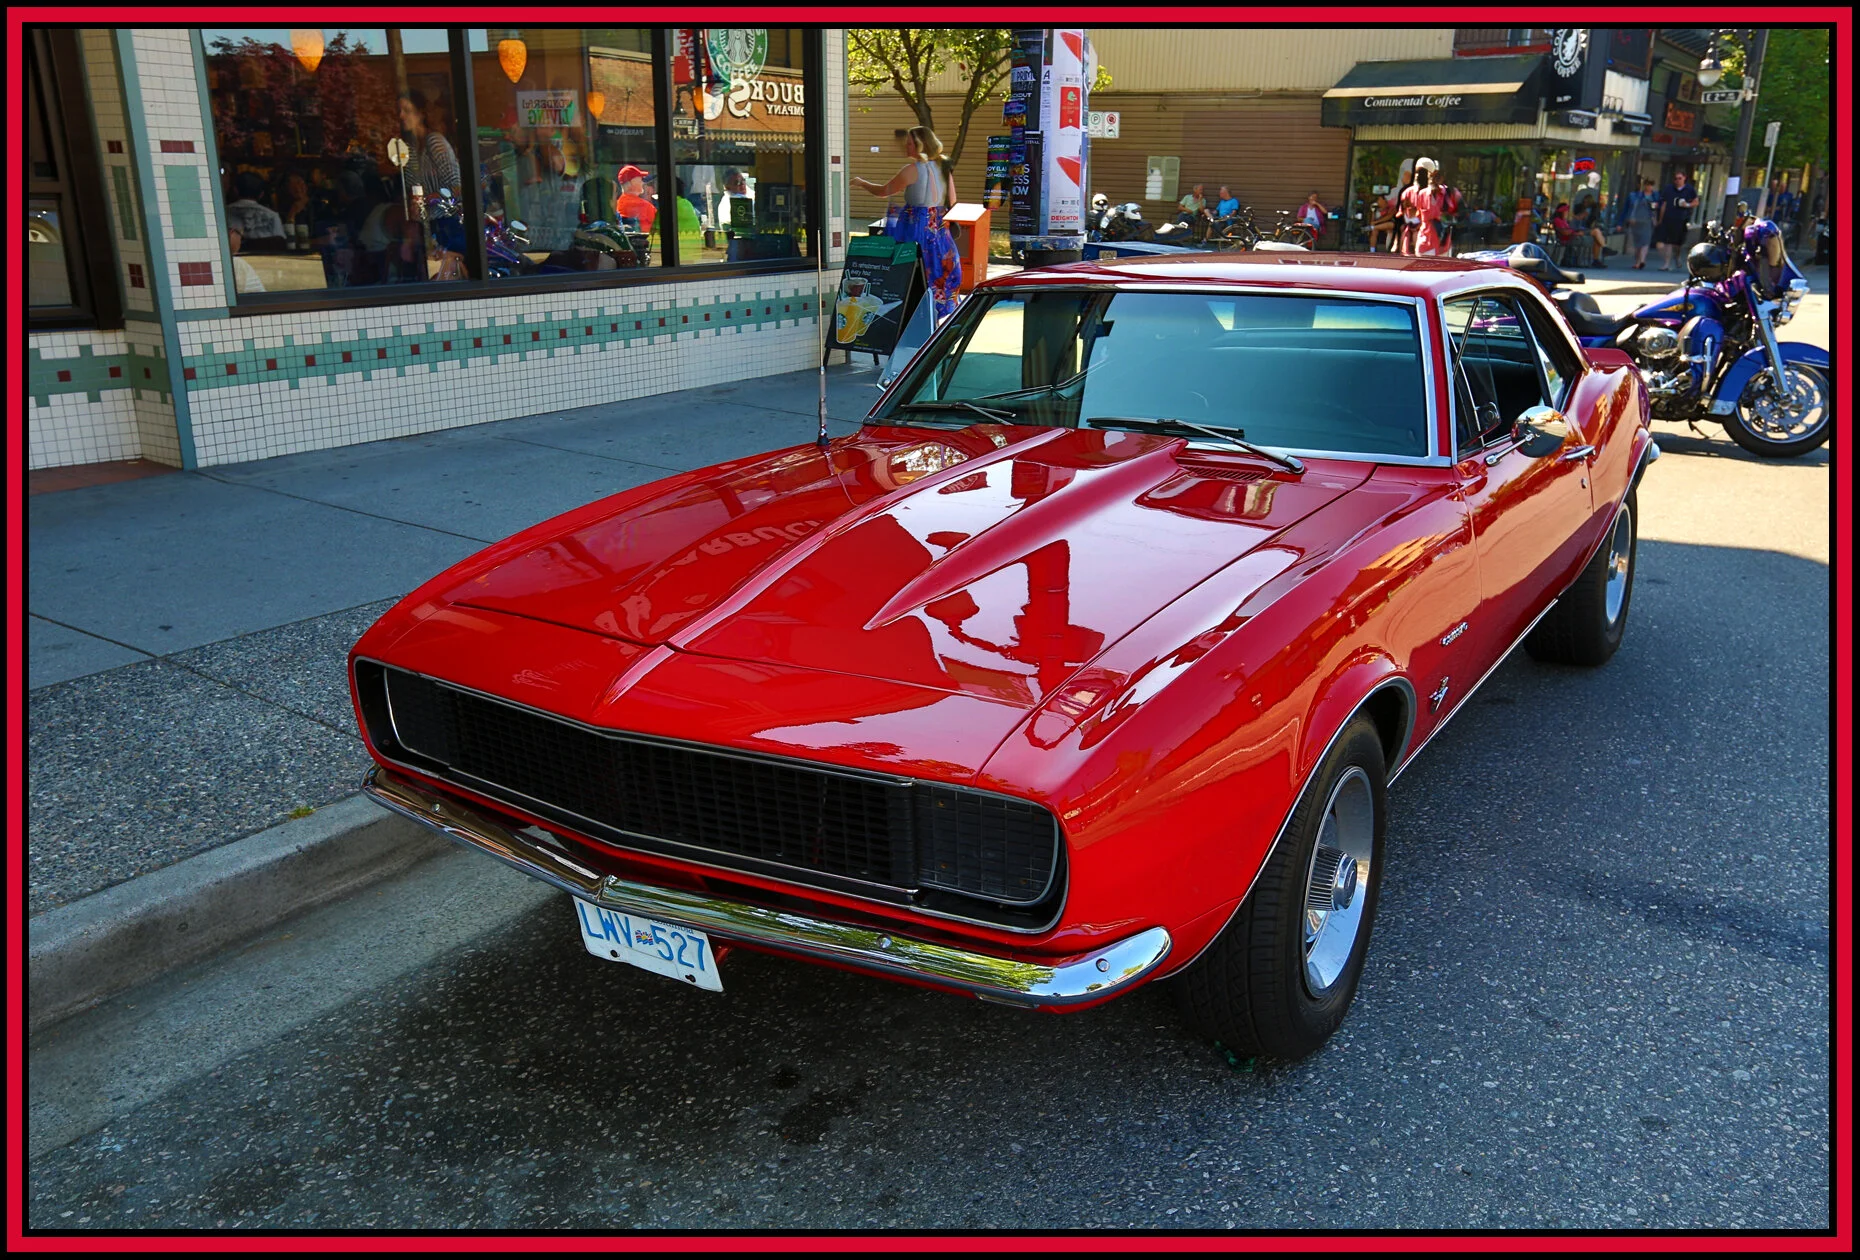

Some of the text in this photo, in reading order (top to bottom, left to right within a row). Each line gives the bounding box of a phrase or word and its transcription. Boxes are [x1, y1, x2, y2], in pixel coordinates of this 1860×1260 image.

[715, 54, 759, 79] COFFEE
[1554, 57, 1582, 78] COFFEE
[1364, 95, 1462, 108] Continental Coffee
[579, 902, 706, 972] LWV 527
